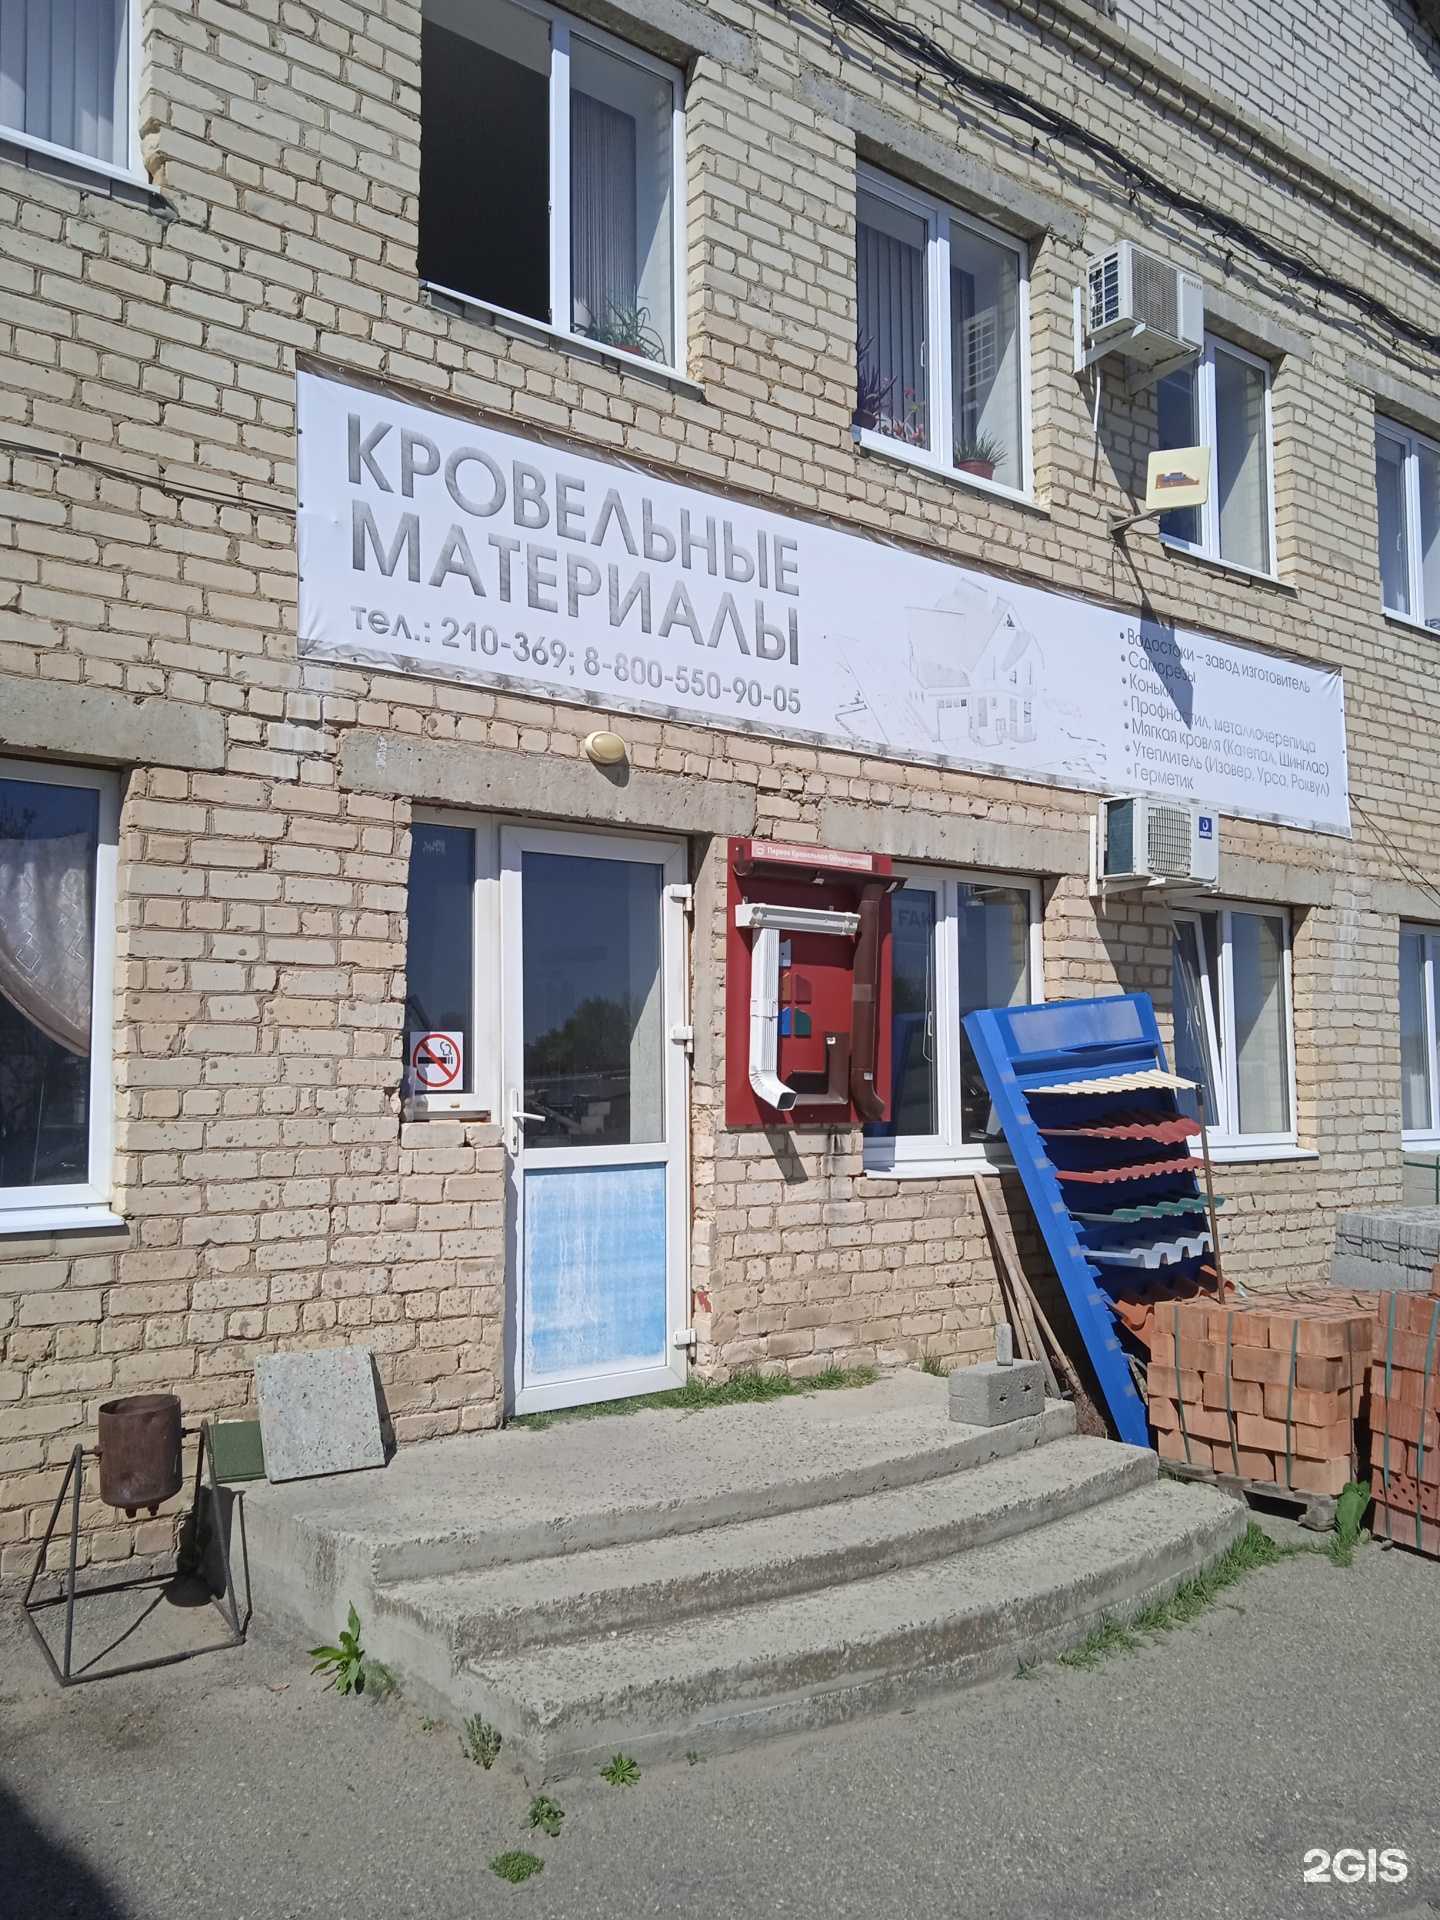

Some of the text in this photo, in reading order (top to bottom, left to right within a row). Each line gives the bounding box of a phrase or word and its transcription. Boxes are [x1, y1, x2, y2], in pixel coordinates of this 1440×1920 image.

[348, 412, 800, 597] КРОВЕЛЬНЫЕ
[352, 498, 799, 666] МАТЕРИАЛЫ
[350, 604, 801, 714] тел.: 210-369; 8-800-550-90-05
[1128, 628, 1194, 660] Водостоки
[1205, 654, 1240, 676] завод
[1242, 664, 1311, 693] изготовитель
[1129, 651, 1196, 683] Саморезы
[1129, 673, 1175, 698] Коньки
[1132, 718, 1177, 743] Мягкая
[1180, 732, 1221, 752] кровля
[1279, 752, 1329, 778] Шинглас)
[1133, 740, 1203, 769] Утеплитель
[1214, 719, 1316, 755] металлочерепица
[1134, 762, 1194, 789] Герметик
